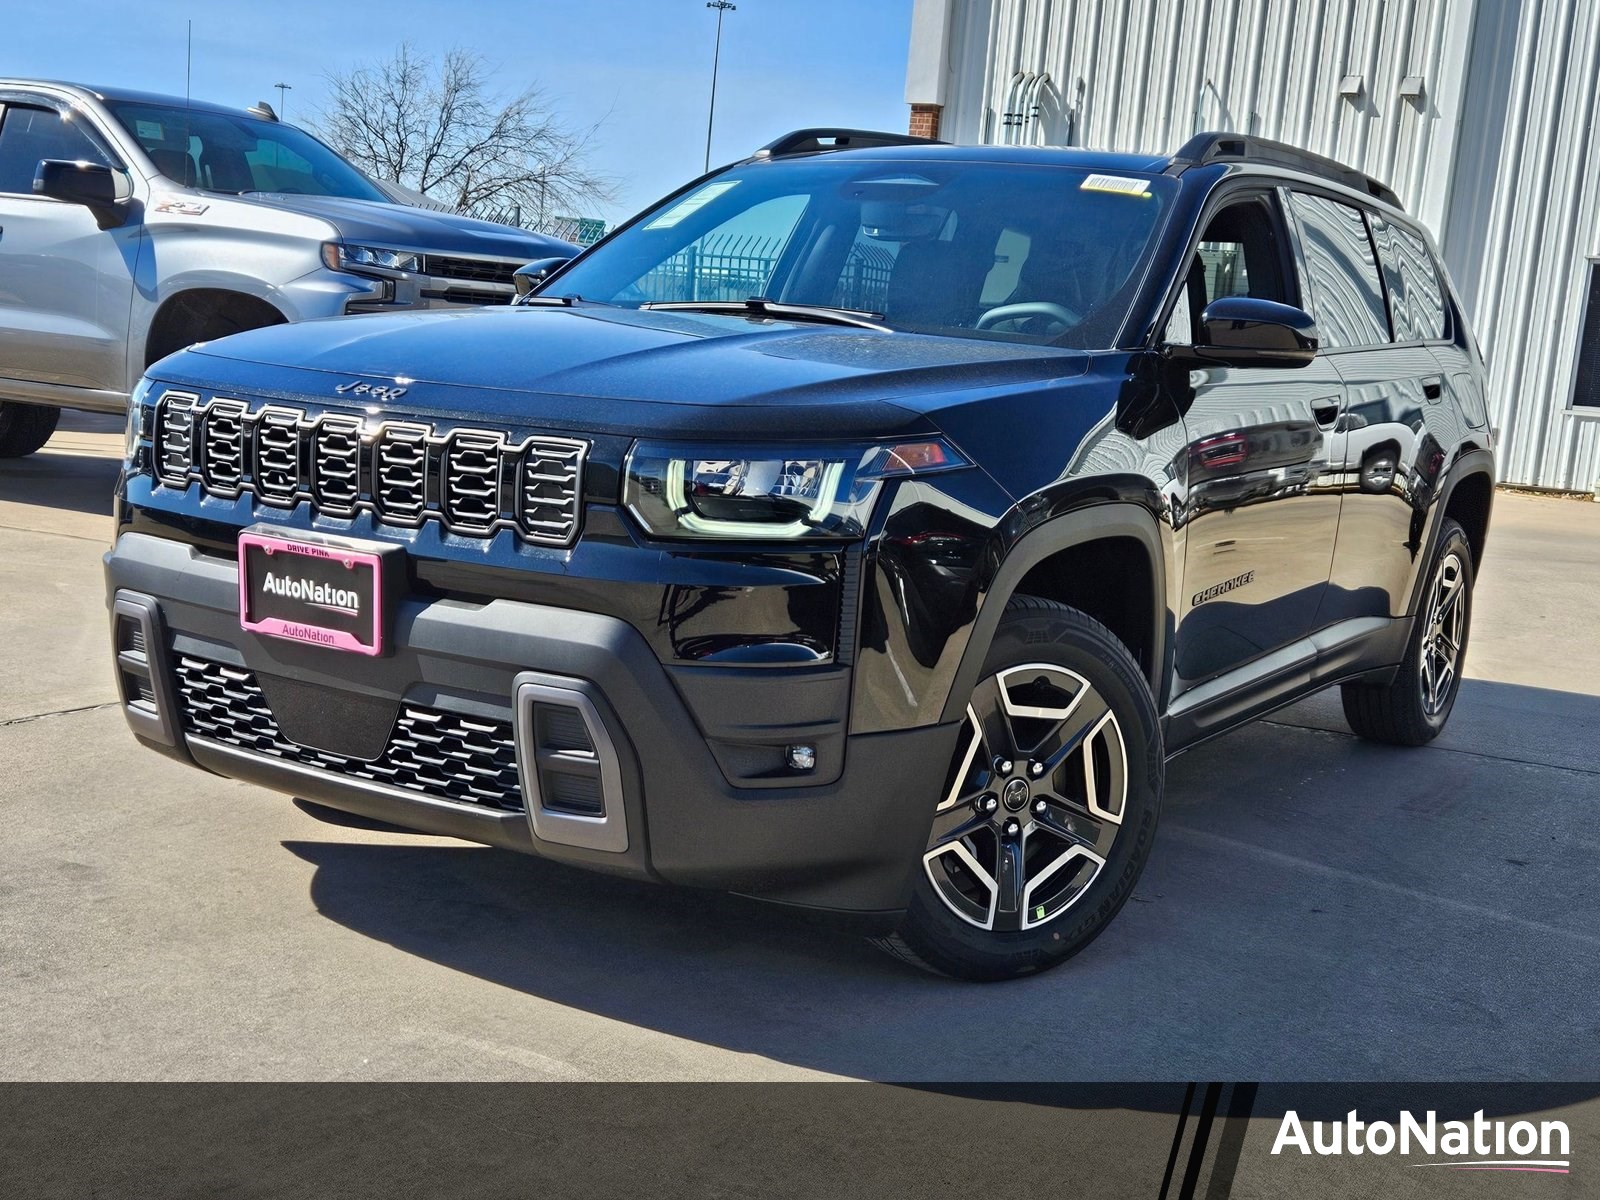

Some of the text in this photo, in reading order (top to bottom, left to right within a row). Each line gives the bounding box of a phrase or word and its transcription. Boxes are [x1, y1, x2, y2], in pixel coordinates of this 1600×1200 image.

[335, 380, 407, 401] Jeep
[287, 543, 330, 558] DRIVE PINK
[262, 571, 360, 609] AutoNation
[1191, 570, 1256, 607] CHEROKEE
[282, 624, 335, 644] AutoNation
